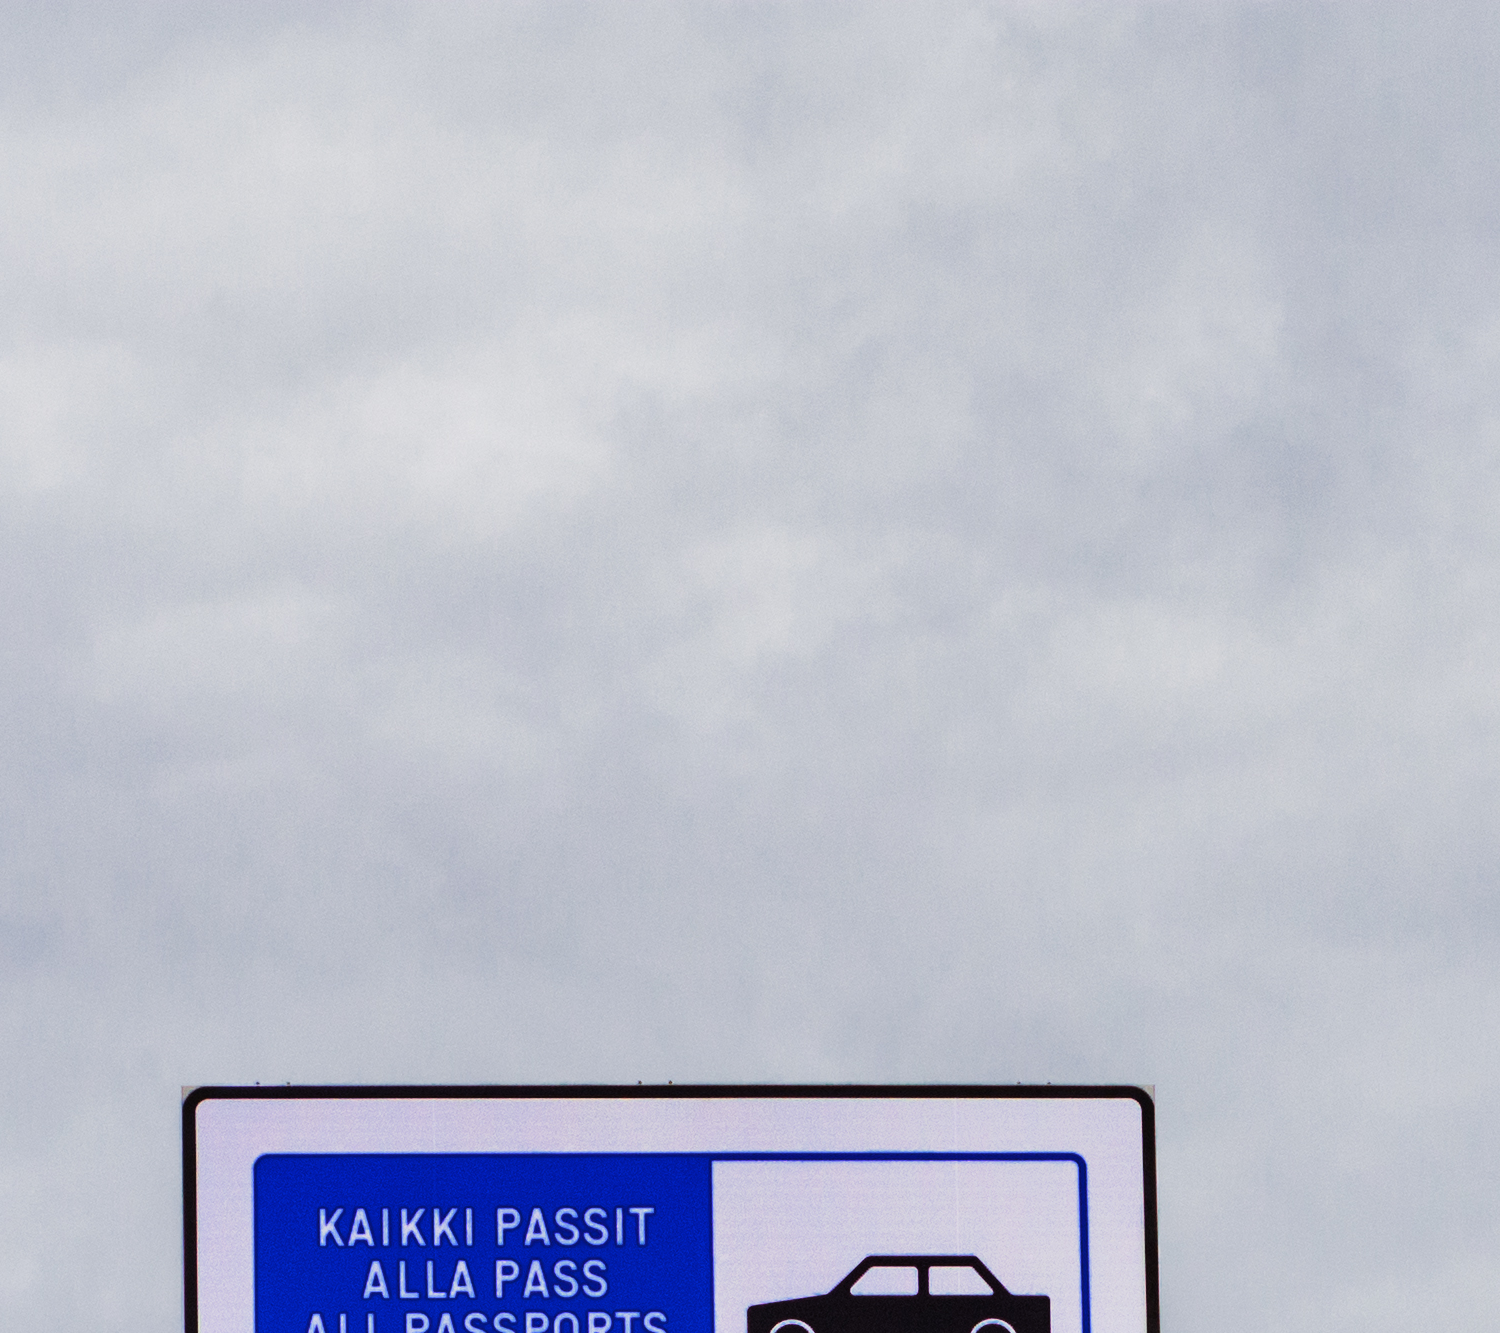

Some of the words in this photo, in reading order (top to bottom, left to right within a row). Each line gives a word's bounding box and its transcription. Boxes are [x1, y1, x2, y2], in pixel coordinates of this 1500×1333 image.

[319, 1208, 473, 1246] KAIKKI
[496, 1207, 654, 1245] PASSIT
[363, 1260, 475, 1299] ALLA
[495, 1259, 607, 1298] PASS
